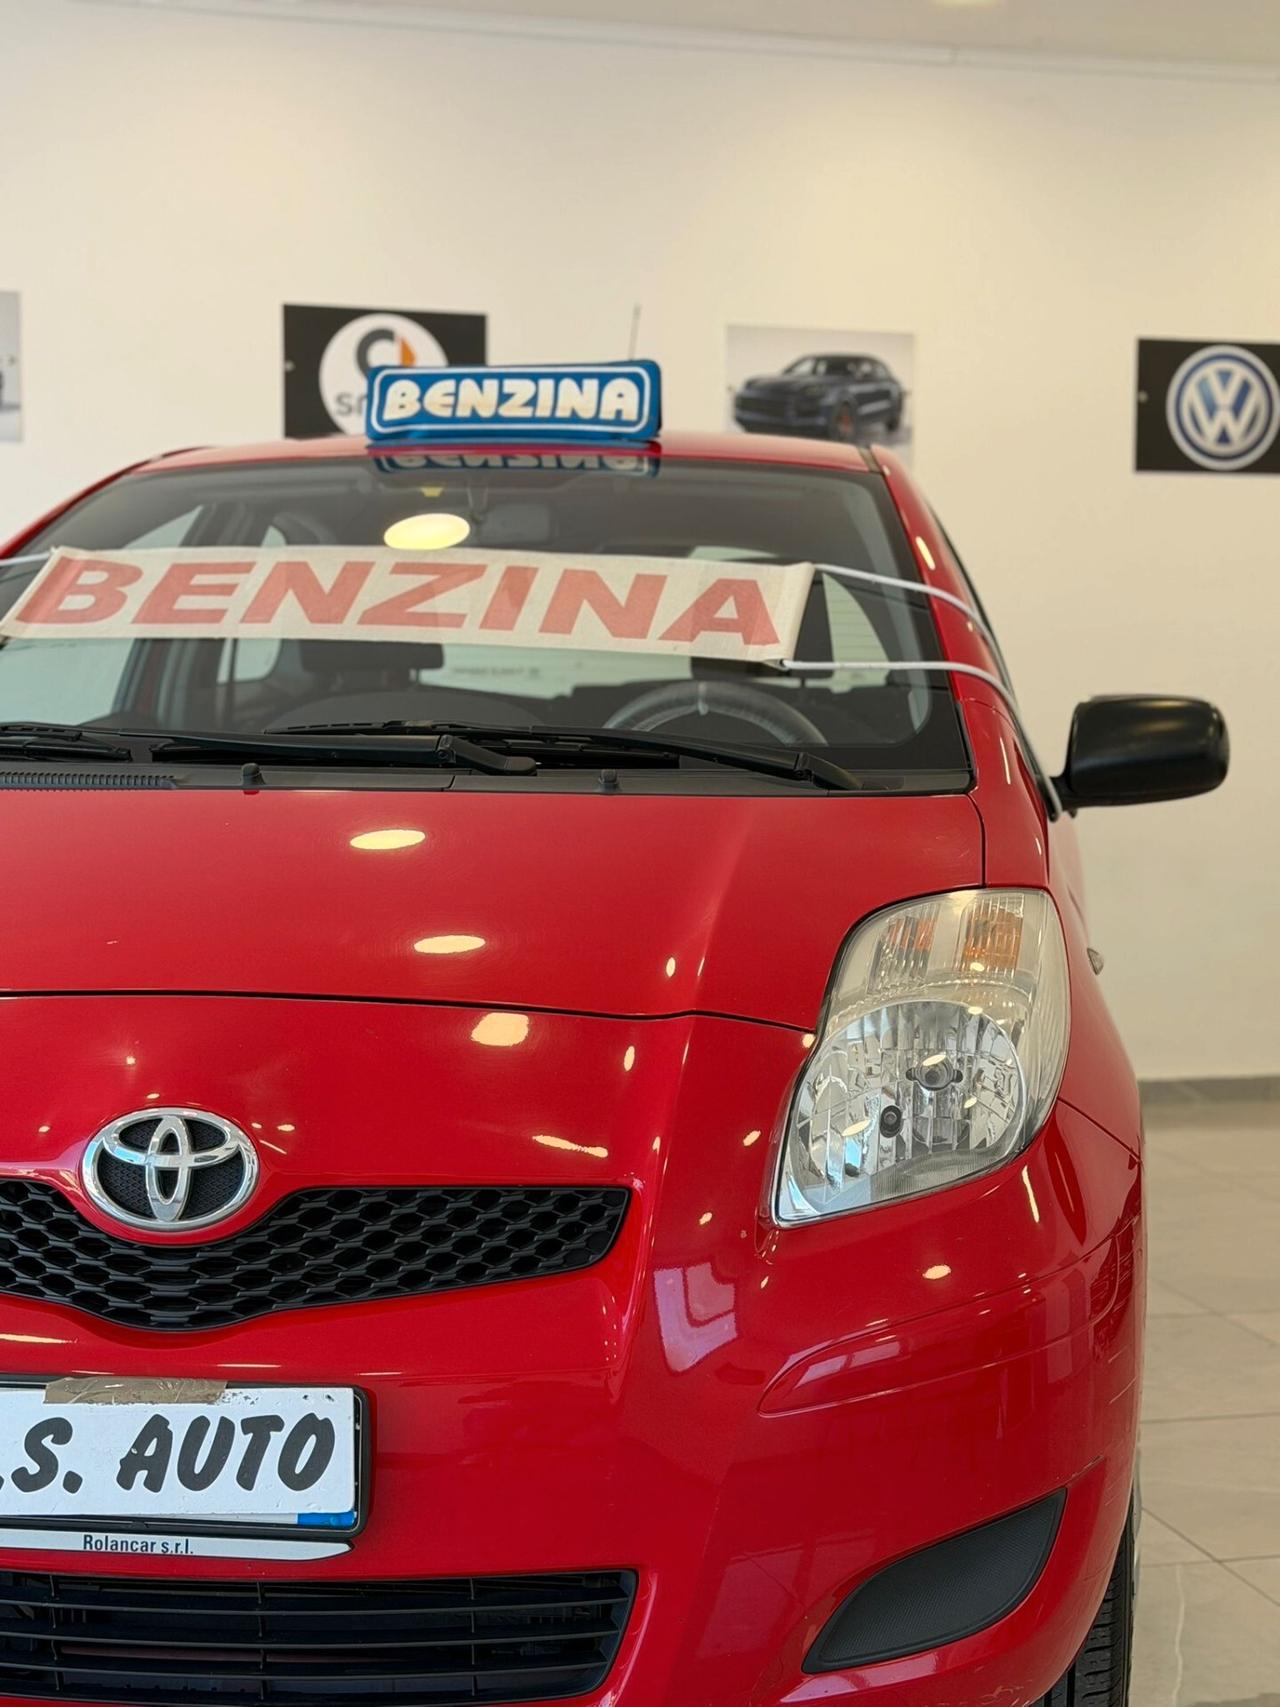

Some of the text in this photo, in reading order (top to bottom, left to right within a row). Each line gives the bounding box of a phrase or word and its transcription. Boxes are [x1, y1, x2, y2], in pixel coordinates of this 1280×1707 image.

[382, 378, 640, 421] BENZINA
[13, 556, 781, 646] BENZINA
[0, 1413, 335, 1494] S. AUTO
[83, 1534, 194, 1554] Rolancar s.r.l.
